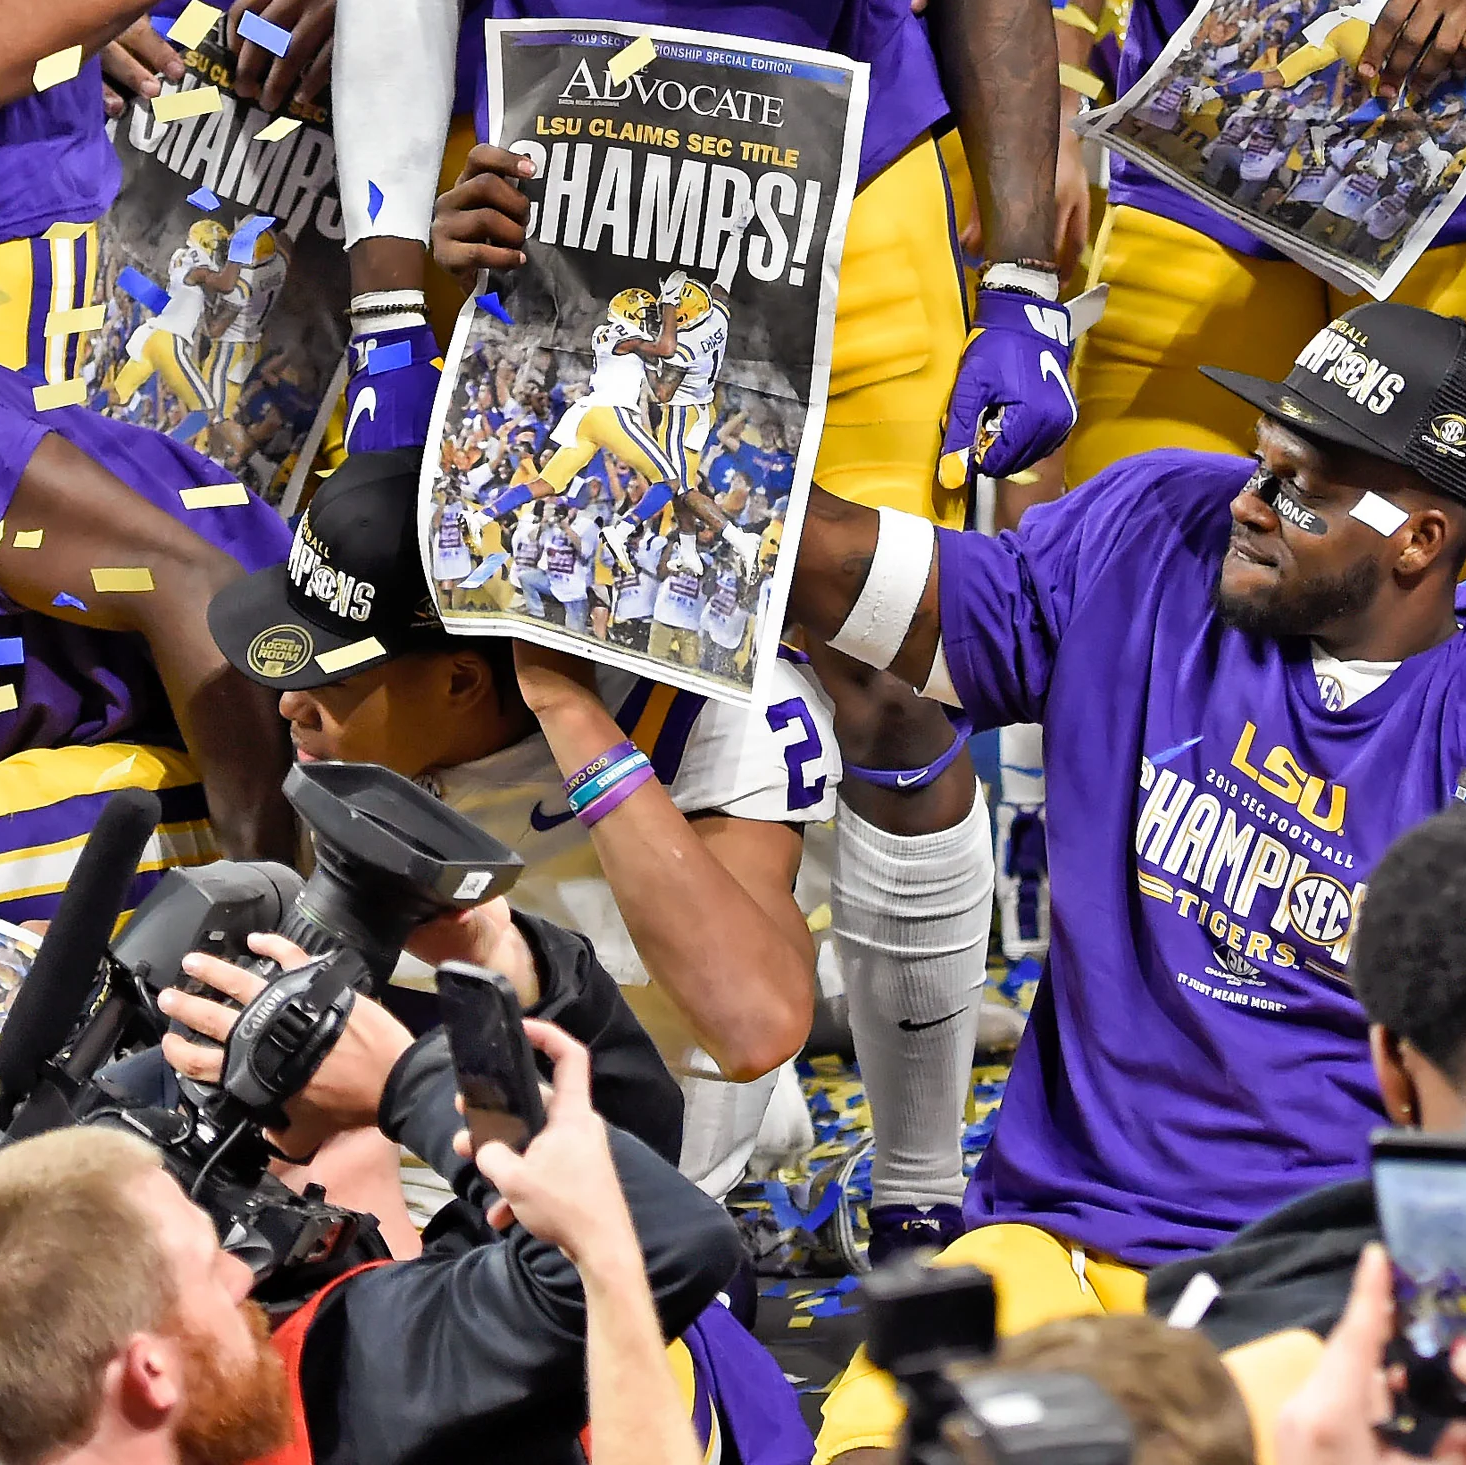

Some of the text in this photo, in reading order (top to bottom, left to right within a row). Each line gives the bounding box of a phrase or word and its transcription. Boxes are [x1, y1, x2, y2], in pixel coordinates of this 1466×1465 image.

[571, 33, 597, 46] 2019
[600, 34, 622, 48] SEC
[706, 49, 749, 67] SPECIAL
[751, 57, 793, 75] EDITION
[557, 57, 786, 128] ADVOCATE
[536, 115, 800, 169] LSU CLAIMS SEC TITLE
[508, 139, 822, 287] CHAMPS!
[1272, 492, 1316, 530] NONE
[257, 650, 299, 662] ROOM
[260, 641, 302, 653] LOCKER
[586, 757, 608, 775] GOD
[766, 697, 828, 812] 2
[1231, 720, 1347, 833] LSU
[1205, 768, 1238, 799] 2019
[1268, 811, 1354, 870] FOOTBALL
[1174, 888, 1297, 968] TIGERS
[1290, 877, 1352, 941] SEC
[239, 988, 286, 1041] Canon
[1176, 972, 1187, 985] IT
[1187, 977, 1212, 998] JUST
[1211, 987, 1249, 1006] MEANS
